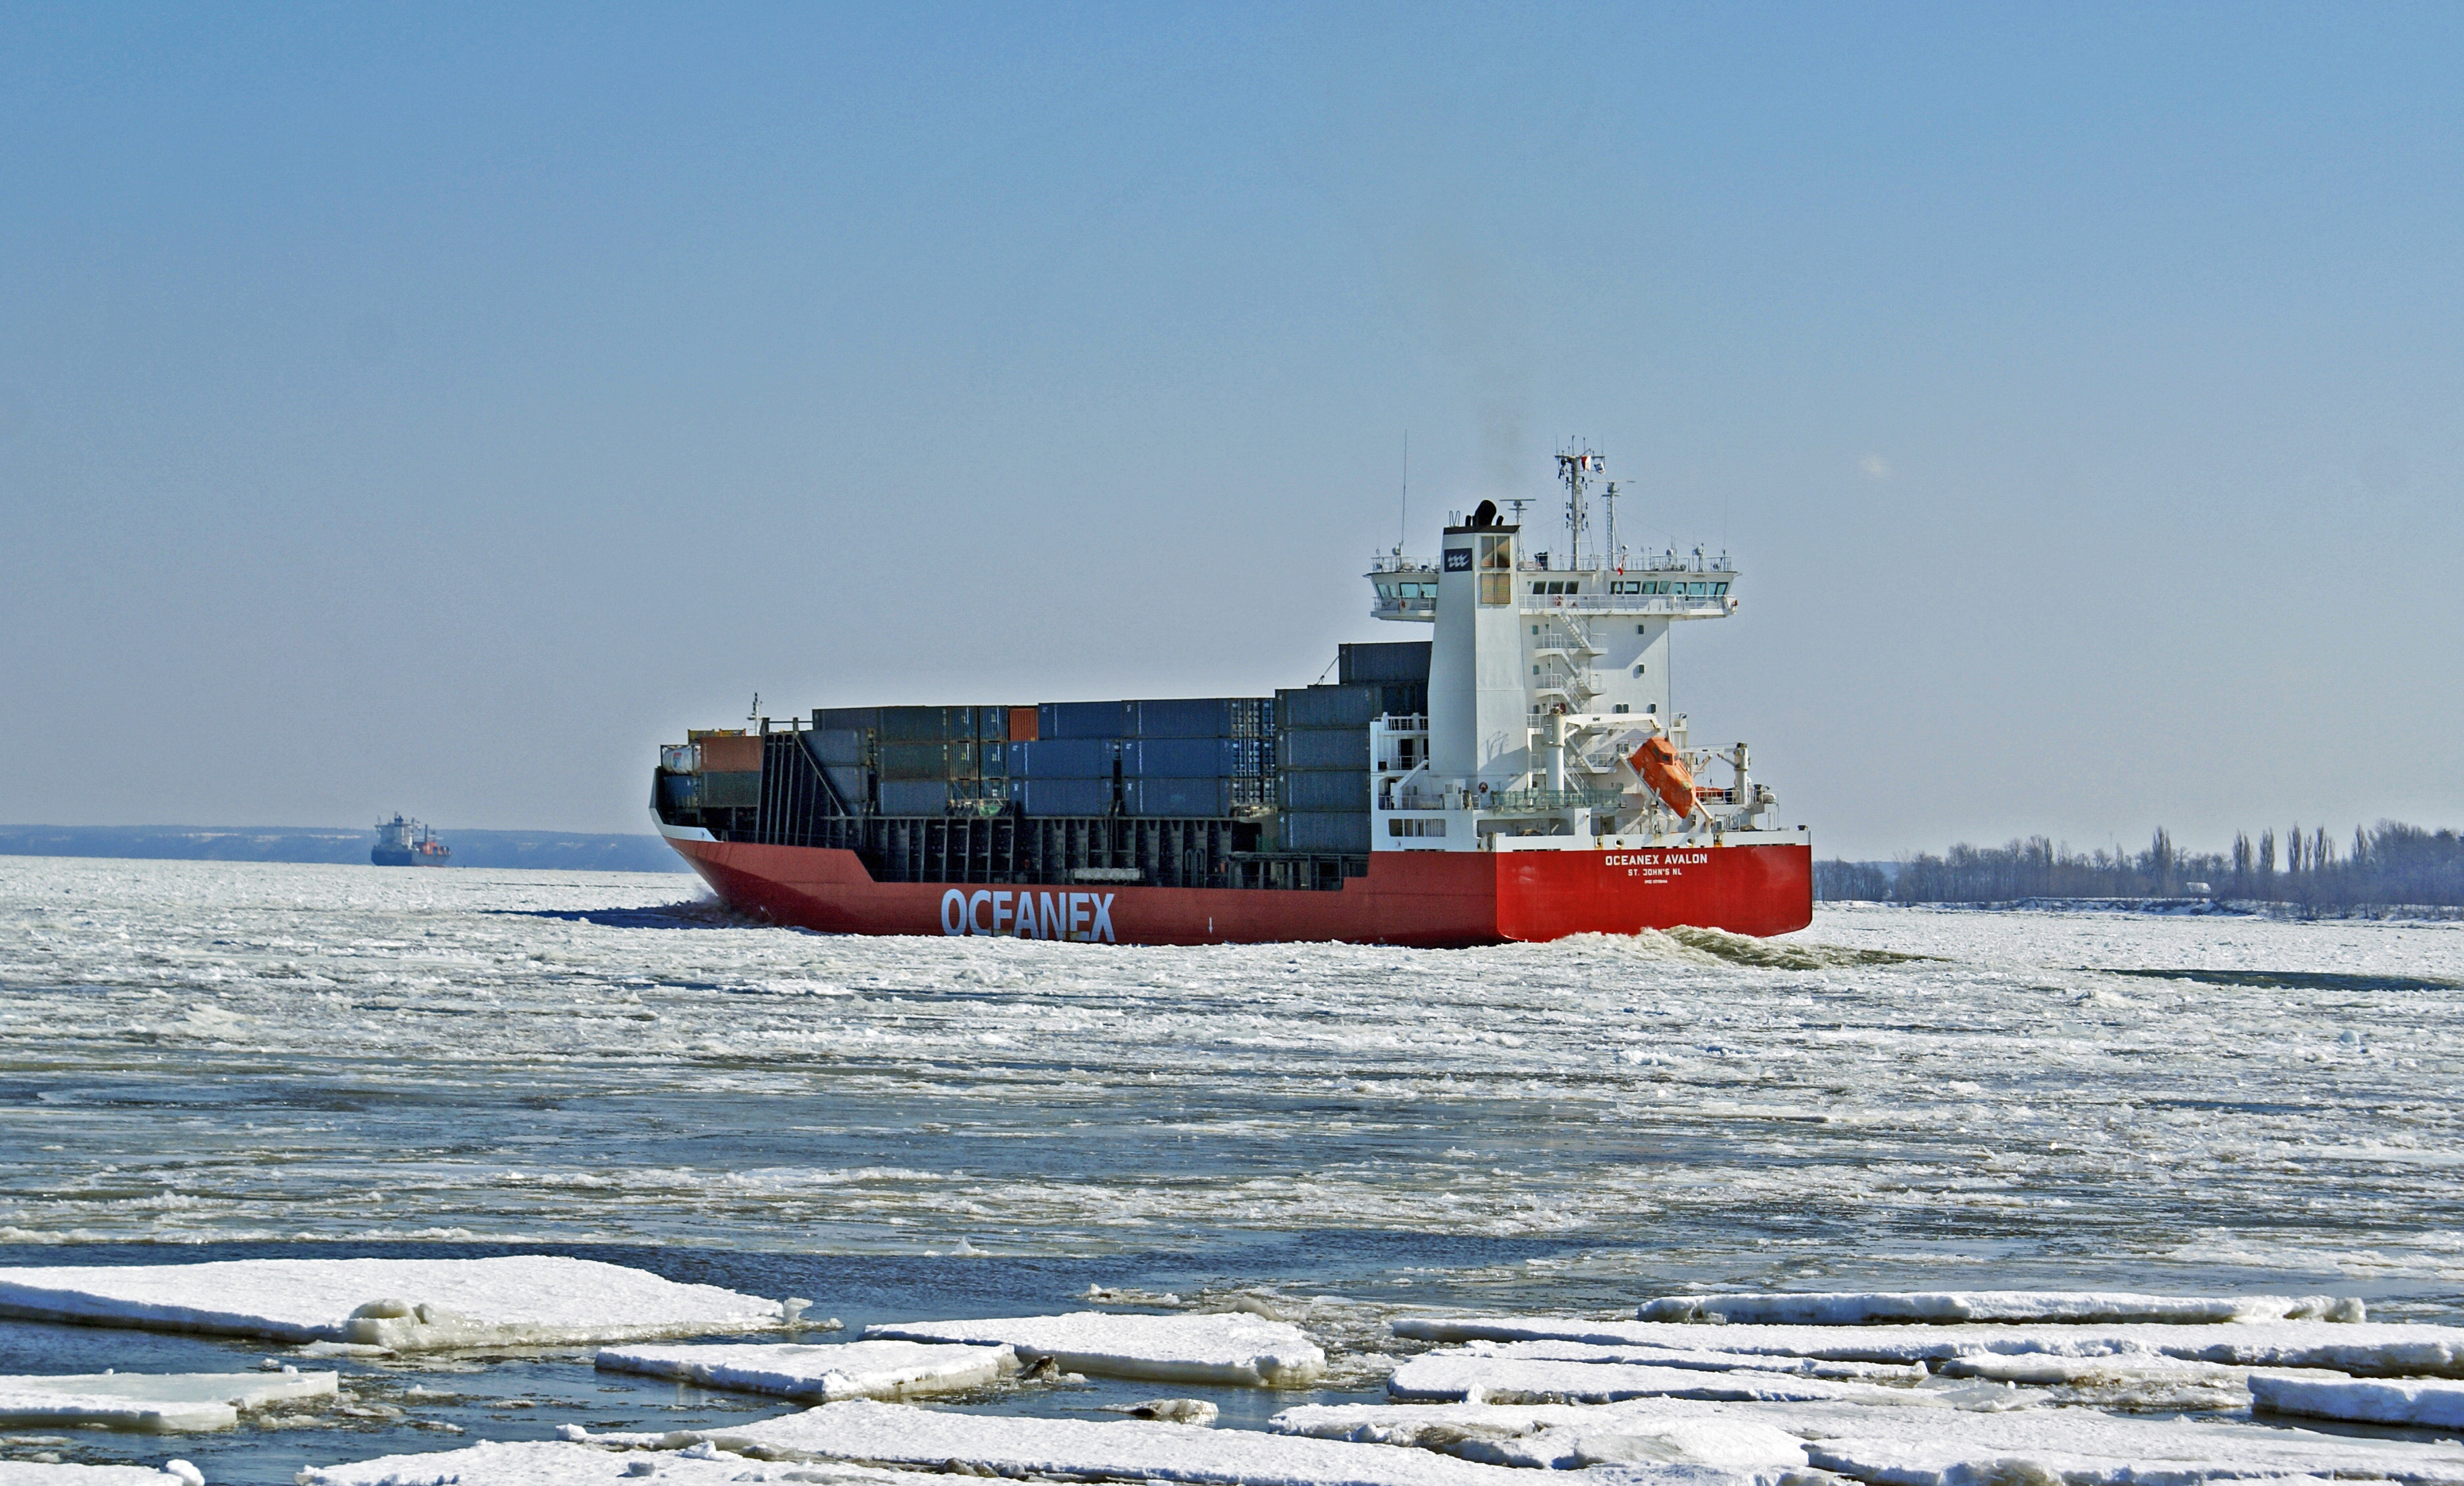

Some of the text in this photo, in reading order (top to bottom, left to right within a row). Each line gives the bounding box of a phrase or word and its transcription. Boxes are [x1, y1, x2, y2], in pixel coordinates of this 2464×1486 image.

[1606, 853, 1707, 866] OCEANEX AVALON
[1643, 868, 1669, 876] JOHN'S
[941, 889, 1116, 942] OCEANEX
